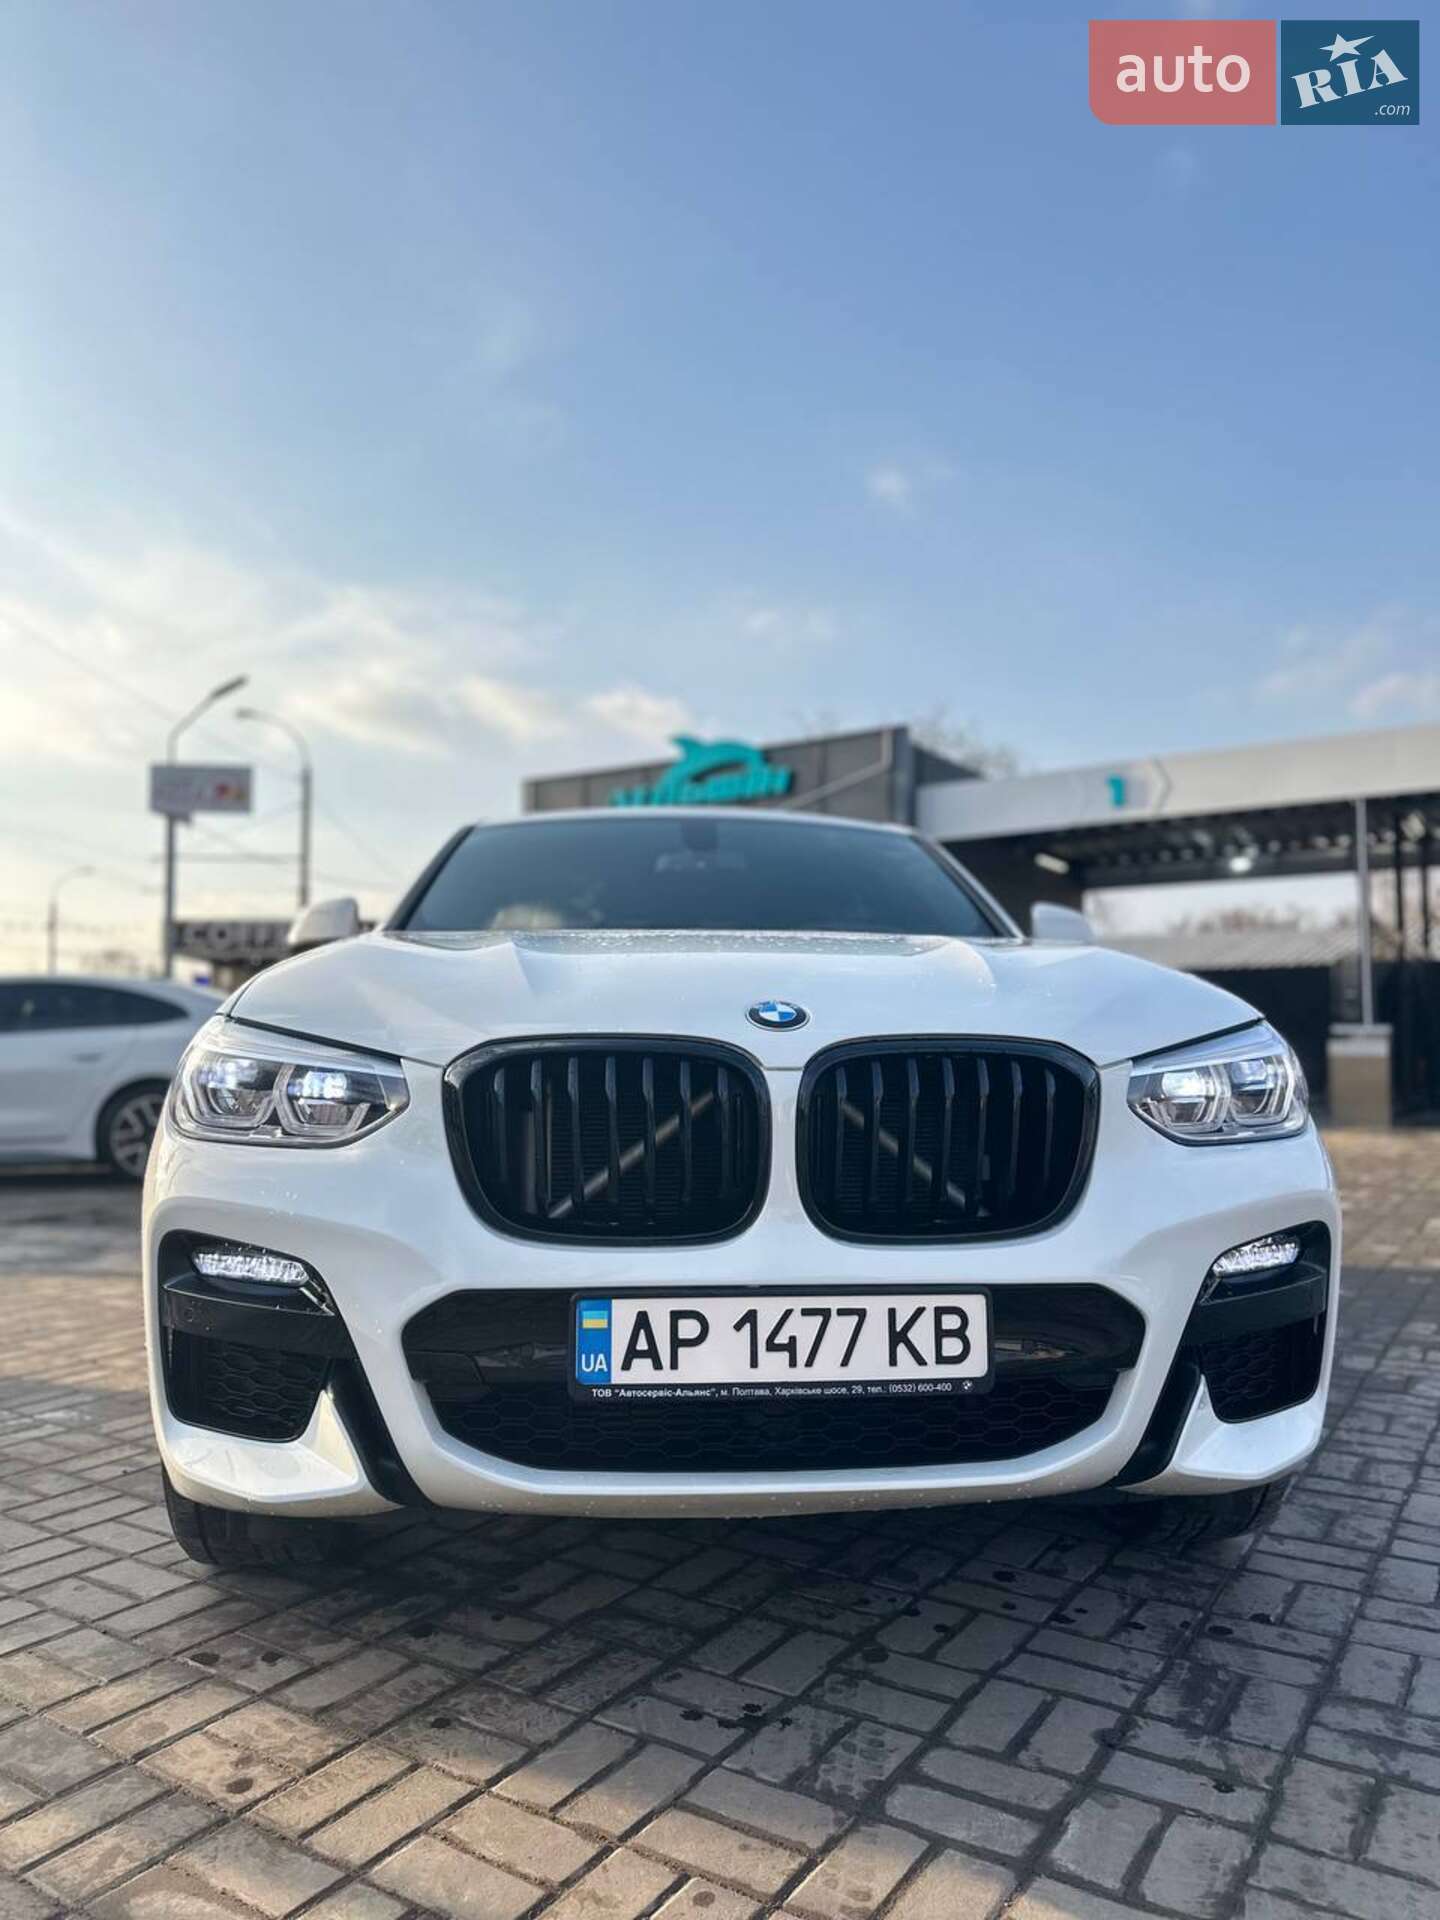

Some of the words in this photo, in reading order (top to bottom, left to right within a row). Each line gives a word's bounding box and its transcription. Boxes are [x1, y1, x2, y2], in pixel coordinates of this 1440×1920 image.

[620, 1309, 710, 1372] AP
[732, 1307, 867, 1370] 1477
[887, 1305, 971, 1368] KB
[581, 1353, 609, 1373] UA
[591, 1387, 613, 1398] ТОВ
[889, 1383, 916, 1394] (0532)
[917, 1382, 952, 1392] 600-400
